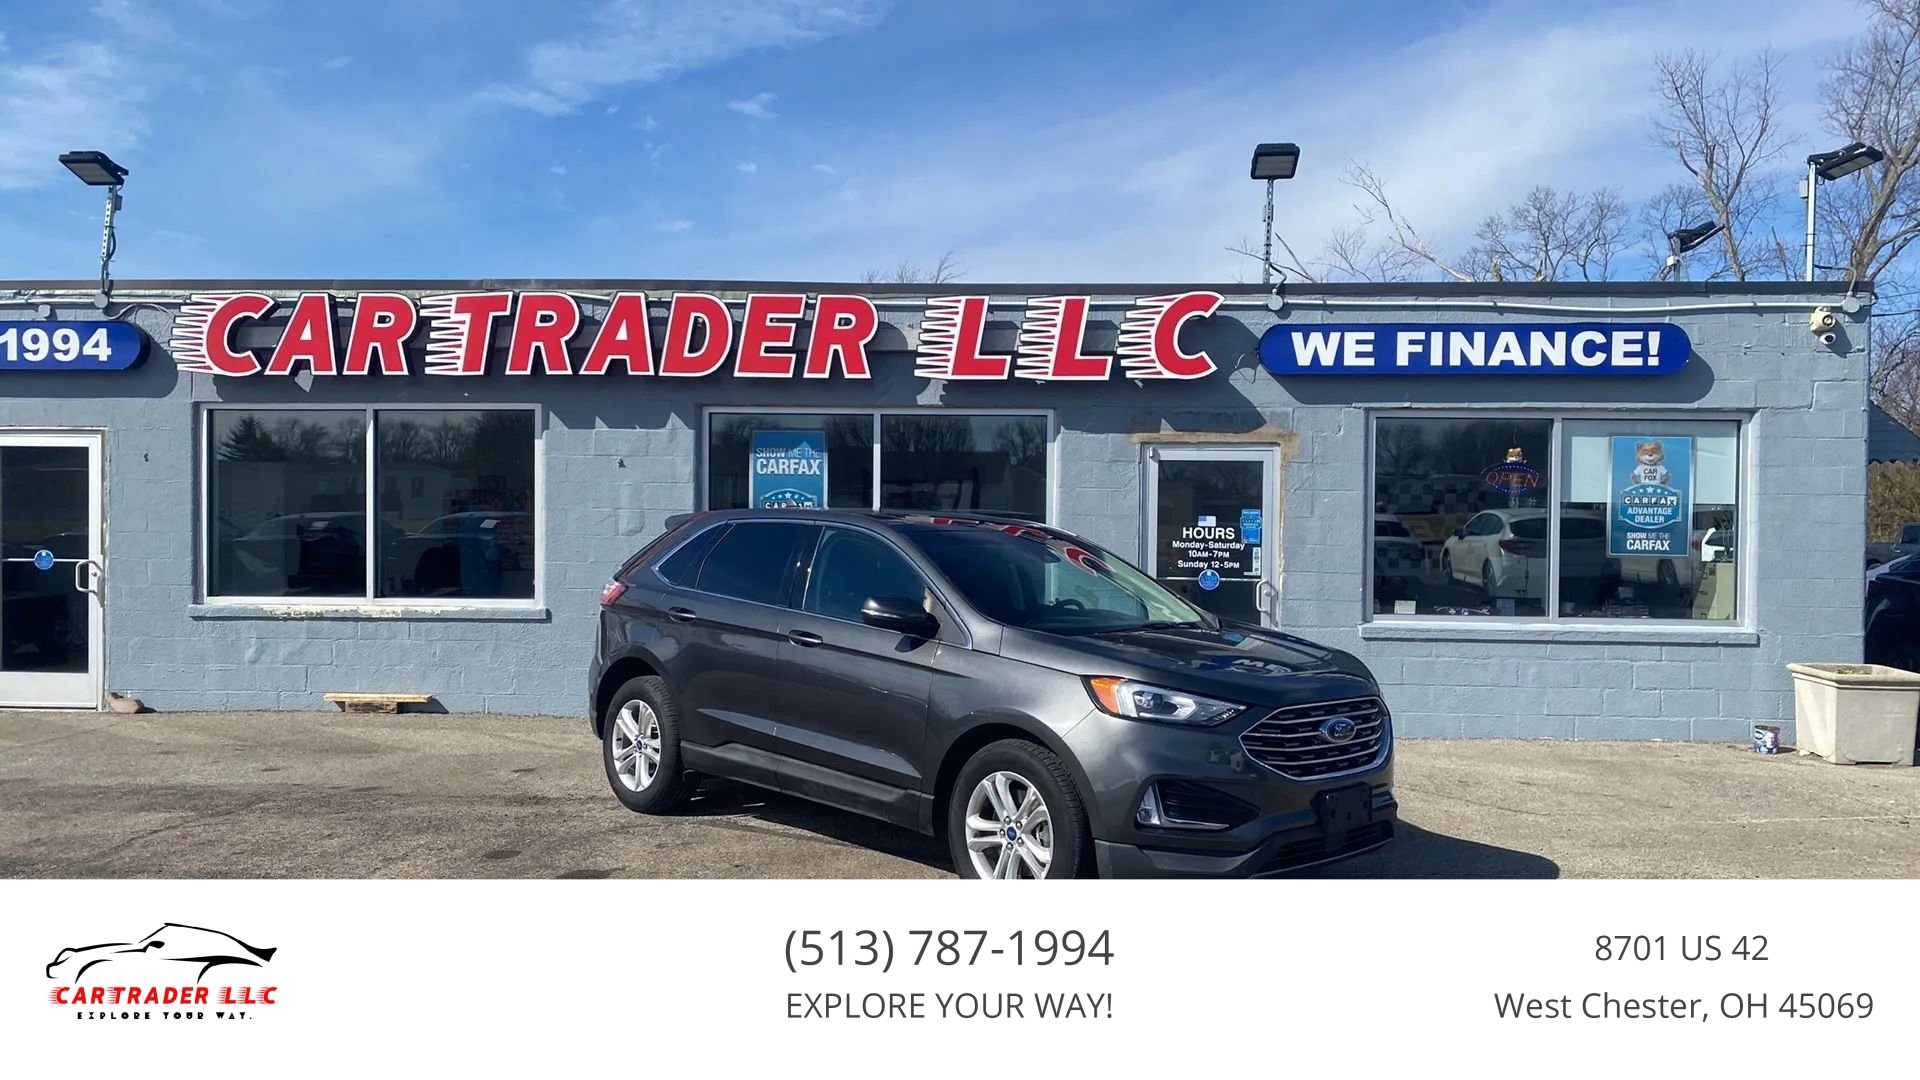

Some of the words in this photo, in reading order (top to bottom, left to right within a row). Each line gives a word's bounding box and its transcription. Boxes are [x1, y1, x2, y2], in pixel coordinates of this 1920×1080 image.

[914, 291, 1225, 380] LLC
[0, 328, 112, 361] 1994
[1291, 331, 1375, 366] WE
[1396, 330, 1660, 367] FINANCE!
[756, 448, 785, 458] SHOW
[788, 448, 801, 458] ME
[805, 448, 821, 458] THE
[757, 459, 821, 475] CARFAX
[1486, 471, 1539, 488] OPEN
[1624, 496, 1677, 506] CARFAX
[1627, 507, 1672, 515] ADVANTAGE
[1634, 515, 1665, 523] DEALER
[1182, 527, 1236, 540] HOURS
[1626, 532, 1647, 540] SHOW
[1648, 532, 1658, 540] ME
[1659, 532, 1671, 540] THE
[1172, 540, 1246, 551] Monday-Saturday
[1626, 540, 1671, 551] CARFAX
[1177, 560, 1208, 569] Sunday
[1210, 561, 1240, 569] 12-5PM
